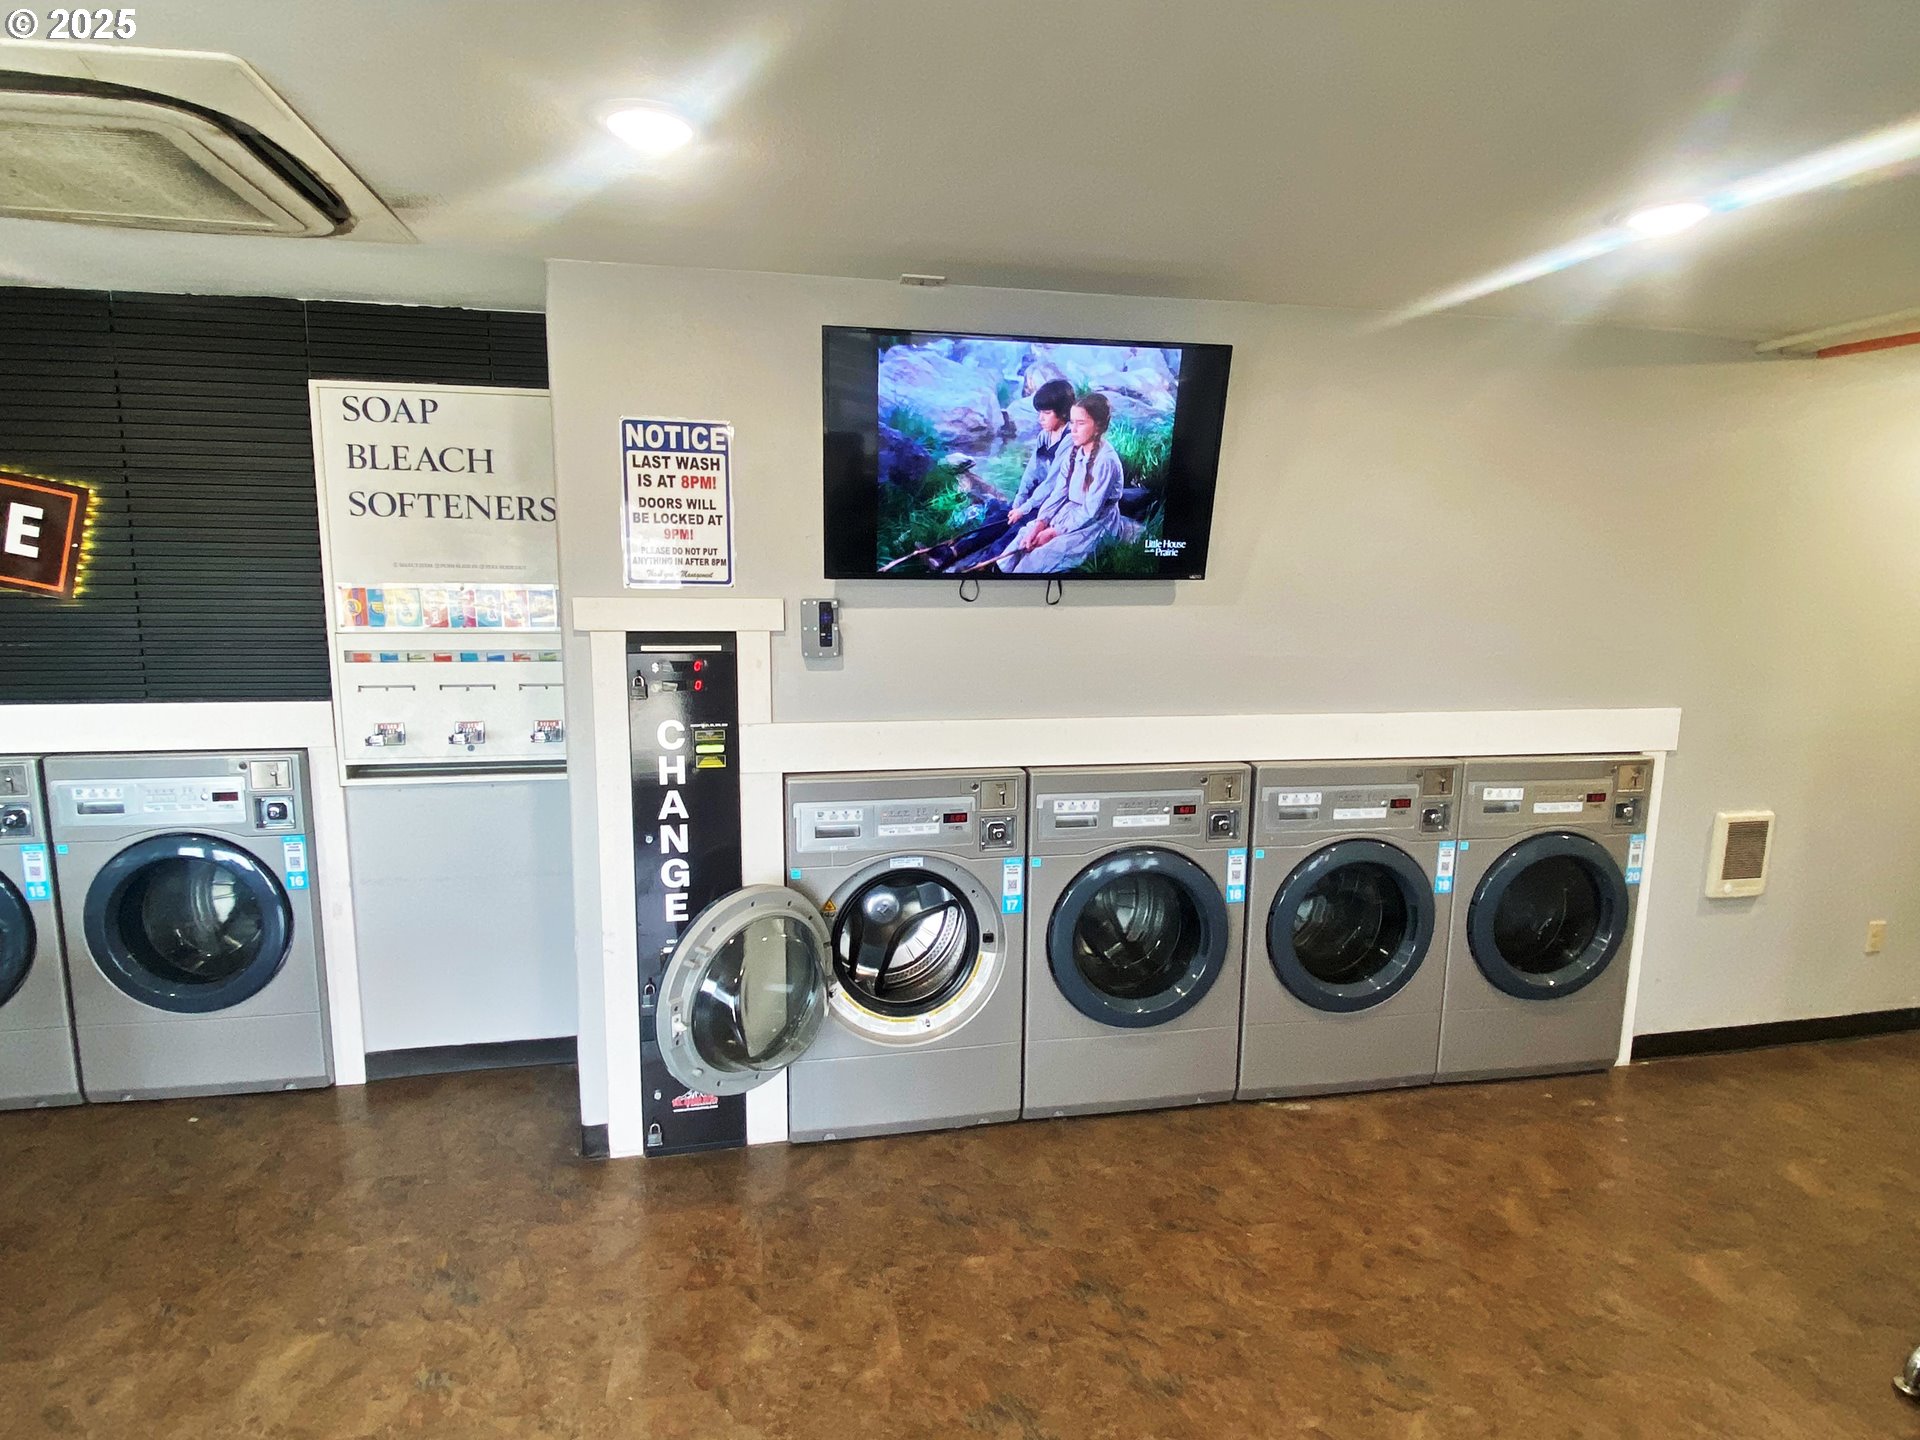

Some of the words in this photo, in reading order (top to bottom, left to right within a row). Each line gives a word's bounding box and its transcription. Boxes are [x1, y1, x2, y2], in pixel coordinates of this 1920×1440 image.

[341, 395, 439, 424] SOAP
[625, 423, 727, 451] NOTICE
[346, 443, 495, 474] BLEACH
[632, 454, 671, 469] LAST
[675, 456, 721, 471] WASH
[637, 473, 653, 488] IS
[657, 475, 676, 488] AT
[681, 475, 717, 490] 8PM!
[348, 491, 556, 522] SOFTENERS
[638, 497, 683, 510] DOORS
[686, 498, 717, 511] WILL
[632, 512, 650, 524] BE
[653, 513, 704, 525] LOCKED
[707, 515, 724, 526] AT
[664, 529, 694, 540] 9PM!
[1144, 539, 1162, 549] Little
[1163, 539, 1187, 549] House
[640, 547, 671, 555] PLEASE
[672, 547, 683, 555] DO
[685, 547, 701, 556] NOT
[702, 548, 718, 556] PUT
[1155, 548, 1179, 557] Prairie
[632, 557, 673, 565] ANYTHING
[675, 557, 683, 565] IN
[685, 558, 709, 566] AFTER
[711, 558, 727, 567] 8PM
[656, 719, 690, 922] CHANGE
[289, 875, 304, 887] 16
[28, 885, 46, 898] 15
[1006, 899, 1019, 911] 17
